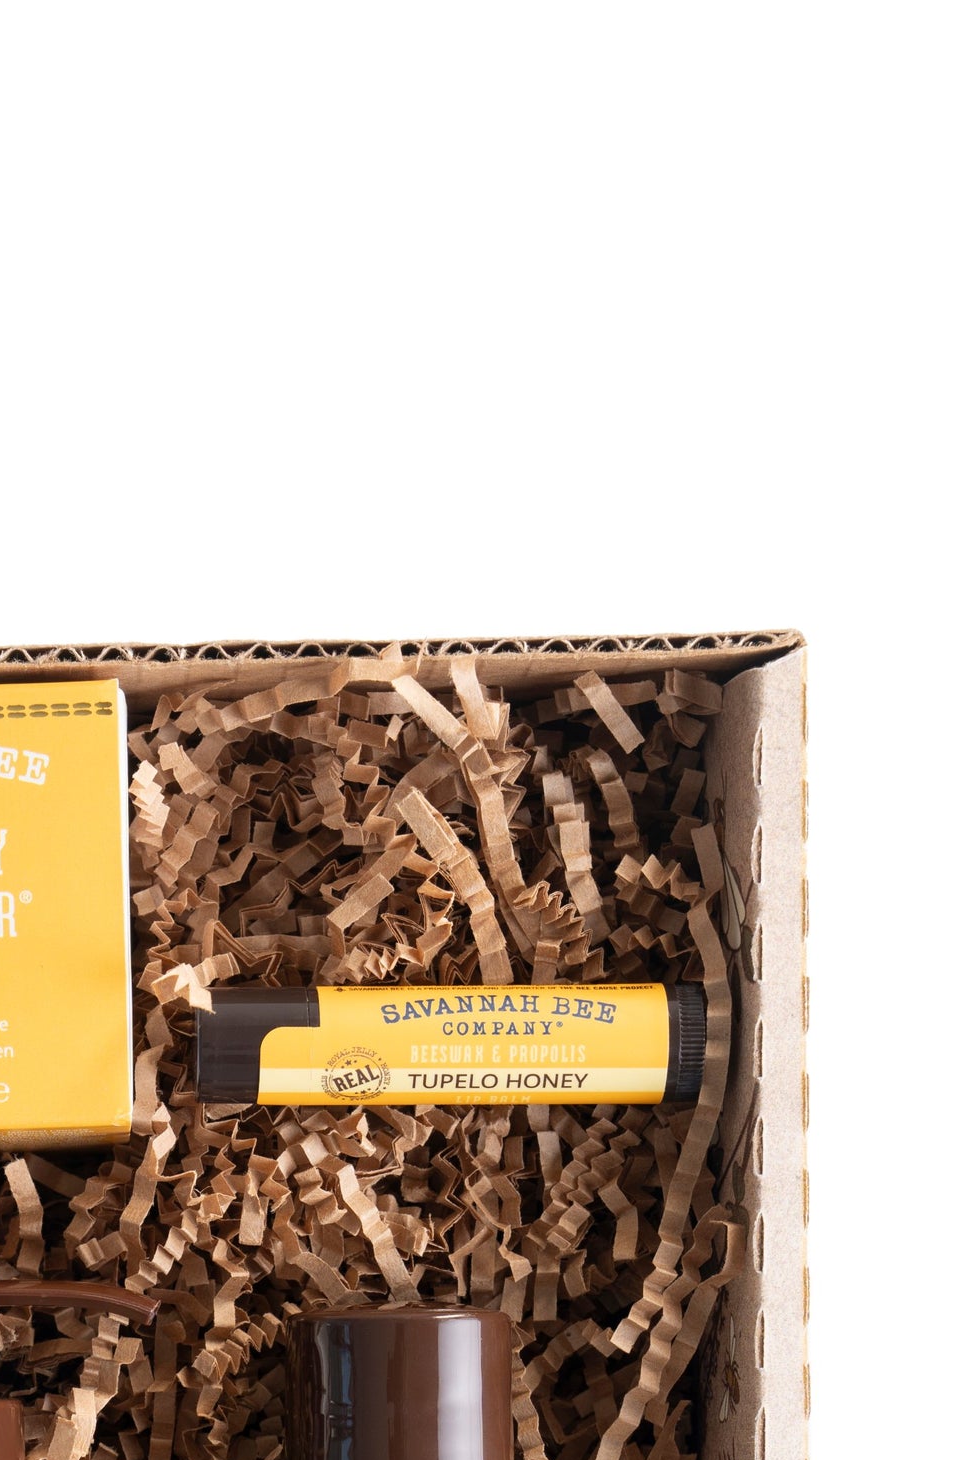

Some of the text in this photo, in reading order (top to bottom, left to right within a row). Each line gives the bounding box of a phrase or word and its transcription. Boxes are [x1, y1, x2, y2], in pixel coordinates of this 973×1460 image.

[381, 995, 617, 1024] SAVANNAH BEE
[327, 1047, 377, 1066] ROYAL JELLY
[411, 1045, 586, 1063] BEESWAX & PROPOLIS
[333, 1065, 379, 1091] REAL
[408, 1074, 588, 1088] TUPELO HONEY
